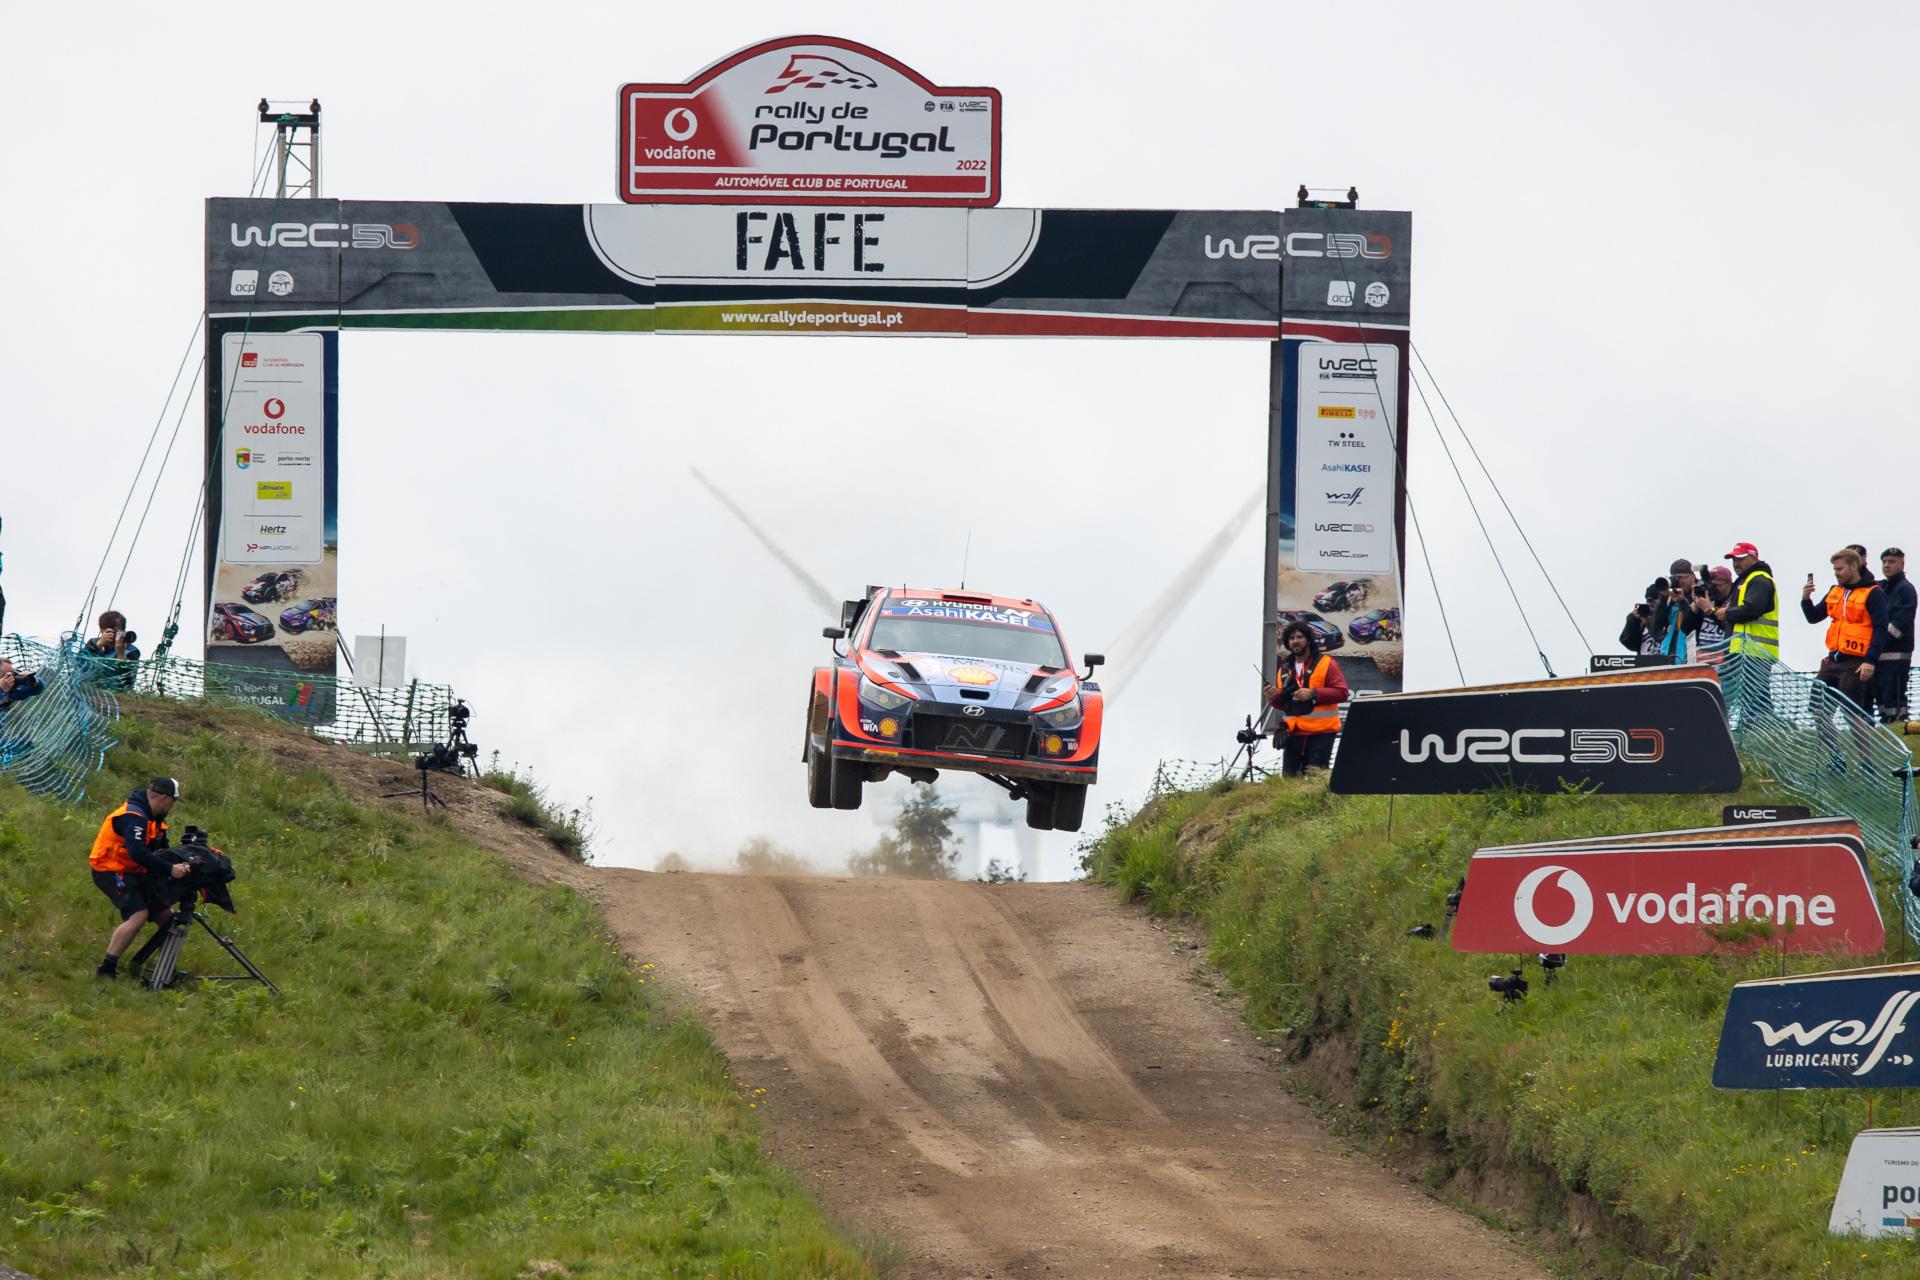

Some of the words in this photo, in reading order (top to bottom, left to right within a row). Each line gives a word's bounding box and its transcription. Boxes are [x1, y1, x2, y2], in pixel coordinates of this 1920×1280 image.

[755, 101, 825, 124] rally
[831, 102, 869, 119] de
[749, 124, 956, 158] Portugal
[644, 145, 716, 160] vodafone
[956, 160, 987, 171] 2022
[715, 175, 789, 188] AUTOMÓVEL
[792, 178, 822, 188] CLUB
[826, 179, 842, 188] DE
[844, 179, 908, 189] PORTUGAL
[736, 211, 885, 273] FAFE
[721, 310, 903, 325] www.rallydeportugal.pt
[1319, 357, 1378, 372] WRC
[244, 423, 305, 435] vodafone
[260, 525, 287, 534] Hertz
[933, 601, 999, 613] HYUNDAI
[1845, 640, 1865, 653] 101
[1594, 657, 1636, 667] WRC
[1733, 808, 1777, 819] WRC
[1606, 882, 1836, 926] vodafone
[1766, 1053, 1860, 1067] LUBRICANTS
[1882, 1185, 1920, 1210] po
